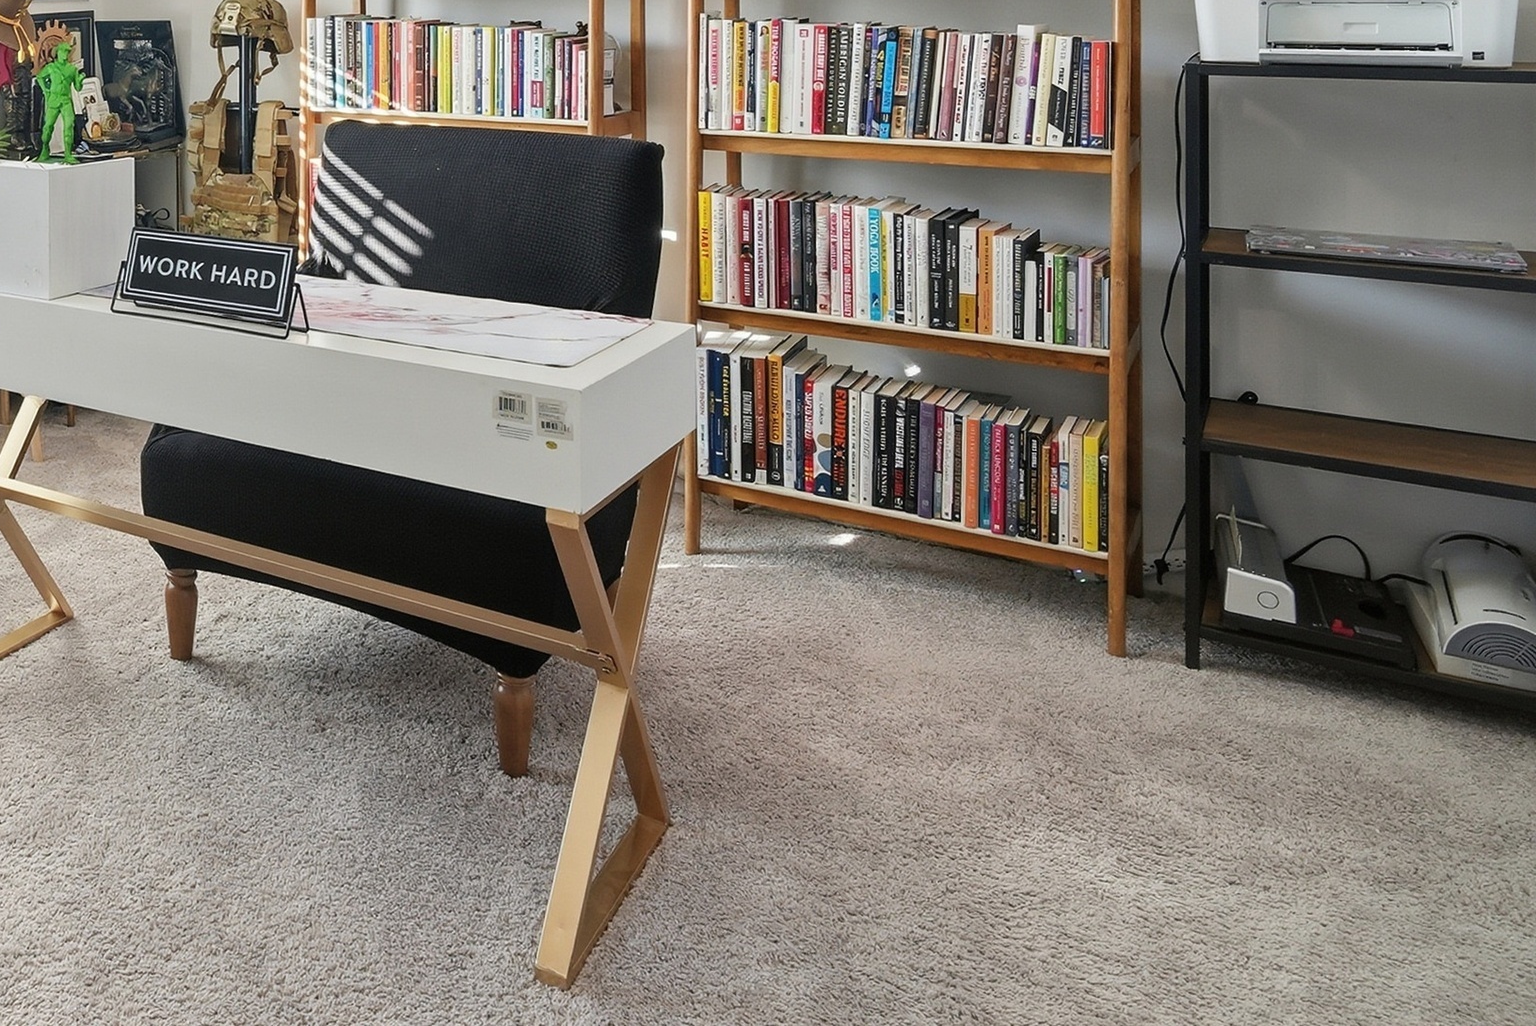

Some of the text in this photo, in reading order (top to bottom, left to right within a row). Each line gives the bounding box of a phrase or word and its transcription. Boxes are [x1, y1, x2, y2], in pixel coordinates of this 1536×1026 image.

[771, 25, 780, 78] THE PROGRAM
[836, 30, 848, 123] AMERICAN SOLDIER
[701, 227, 709, 258] HABIT
[869, 218, 879, 274] YOGA BOOK
[138, 254, 276, 291] WORK HARD
[742, 390, 753, 415] COACHING
[770, 361, 782, 440] REBUILDING MILO
[834, 389, 848, 447] ENDURE
[994, 428, 1002, 452] PATRICK
